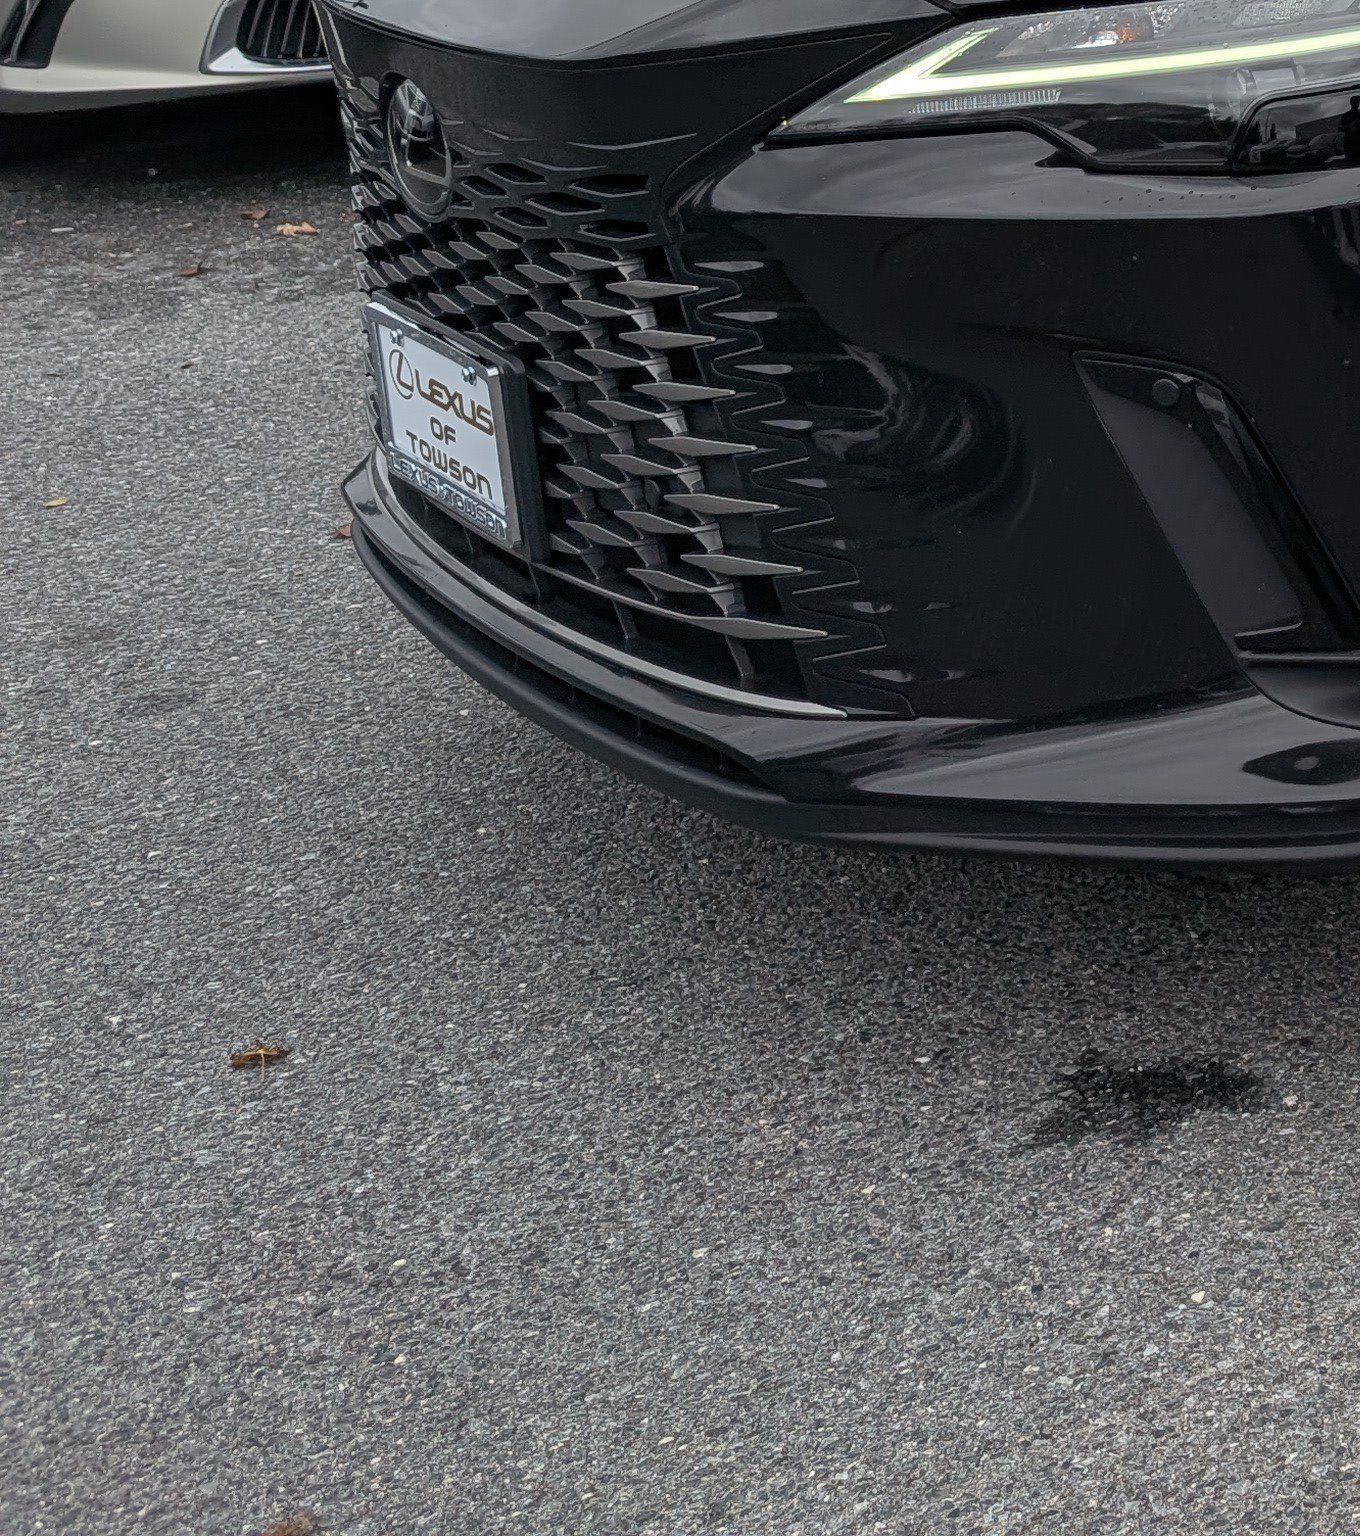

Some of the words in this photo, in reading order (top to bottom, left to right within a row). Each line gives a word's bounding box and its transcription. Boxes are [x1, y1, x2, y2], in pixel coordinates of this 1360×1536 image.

[414, 368, 495, 437] LEXUS
[430, 416, 456, 446] OF
[405, 429, 493, 501] TOWSON
